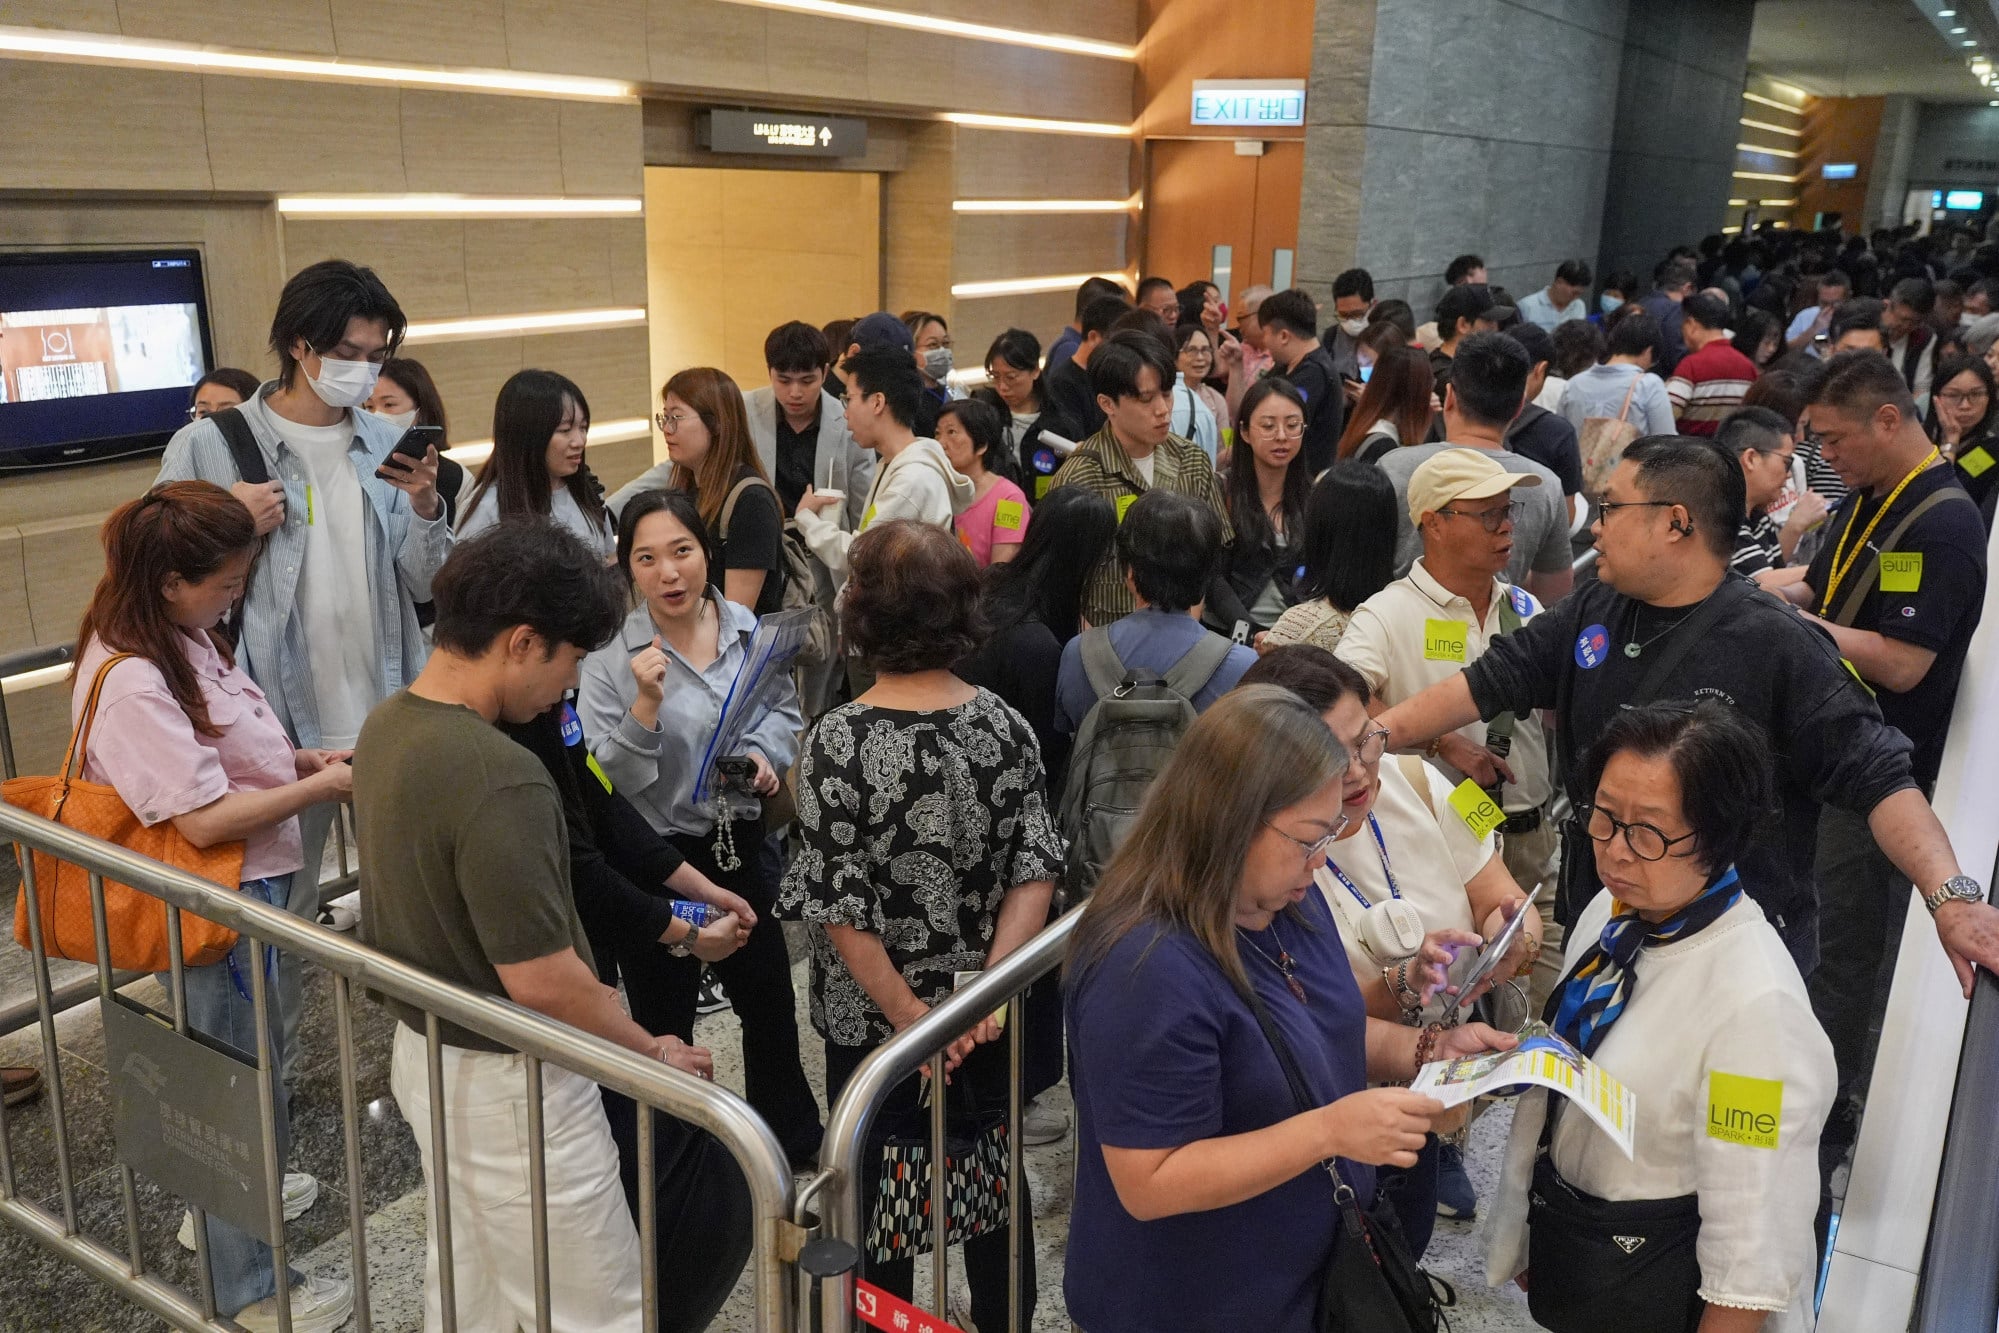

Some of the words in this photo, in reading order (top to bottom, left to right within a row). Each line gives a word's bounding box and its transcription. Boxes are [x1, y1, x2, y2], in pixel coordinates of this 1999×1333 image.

[1195, 97, 1256, 119] EXIT
[1259, 97, 1301, 120] 出口
[1426, 638, 1464, 653] Lime
[1693, 687, 1725, 697] RETURN
[1725, 694, 1735, 705] TO
[680, 905, 689, 921] aqu
[1711, 1103, 1776, 1134] Lime
[1710, 1126, 1745, 1142] SPARK
